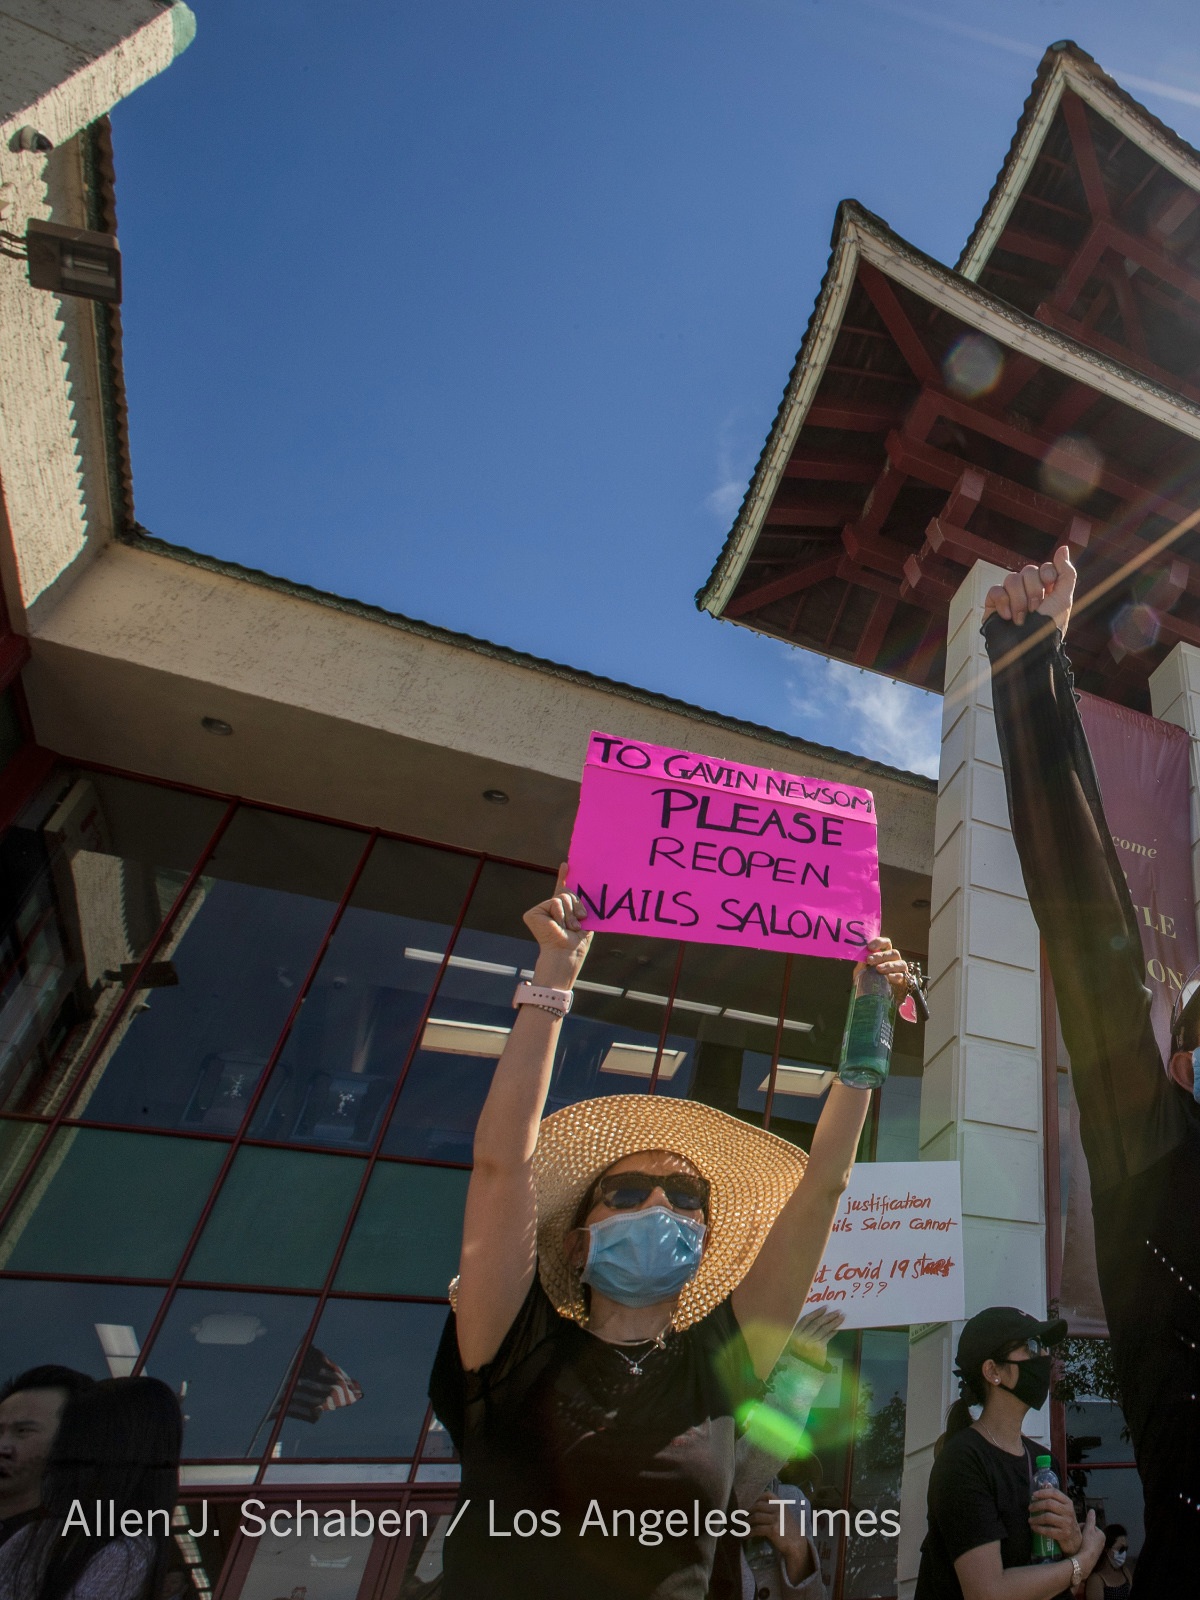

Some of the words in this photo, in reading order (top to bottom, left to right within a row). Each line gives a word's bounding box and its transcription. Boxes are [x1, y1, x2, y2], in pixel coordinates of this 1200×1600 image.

[593, 737, 651, 769] TO
[663, 754, 758, 791] GAVIN
[766, 776, 872, 813] NEWSOM
[651, 788, 844, 847] PLEASE
[649, 836, 830, 888] REOPEN
[1112, 836, 1157, 859] come
[576, 883, 700, 927] NAILS
[717, 899, 868, 947] SALONS
[844, 1192, 931, 1215] justification
[890, 1259, 910, 1279] 19
